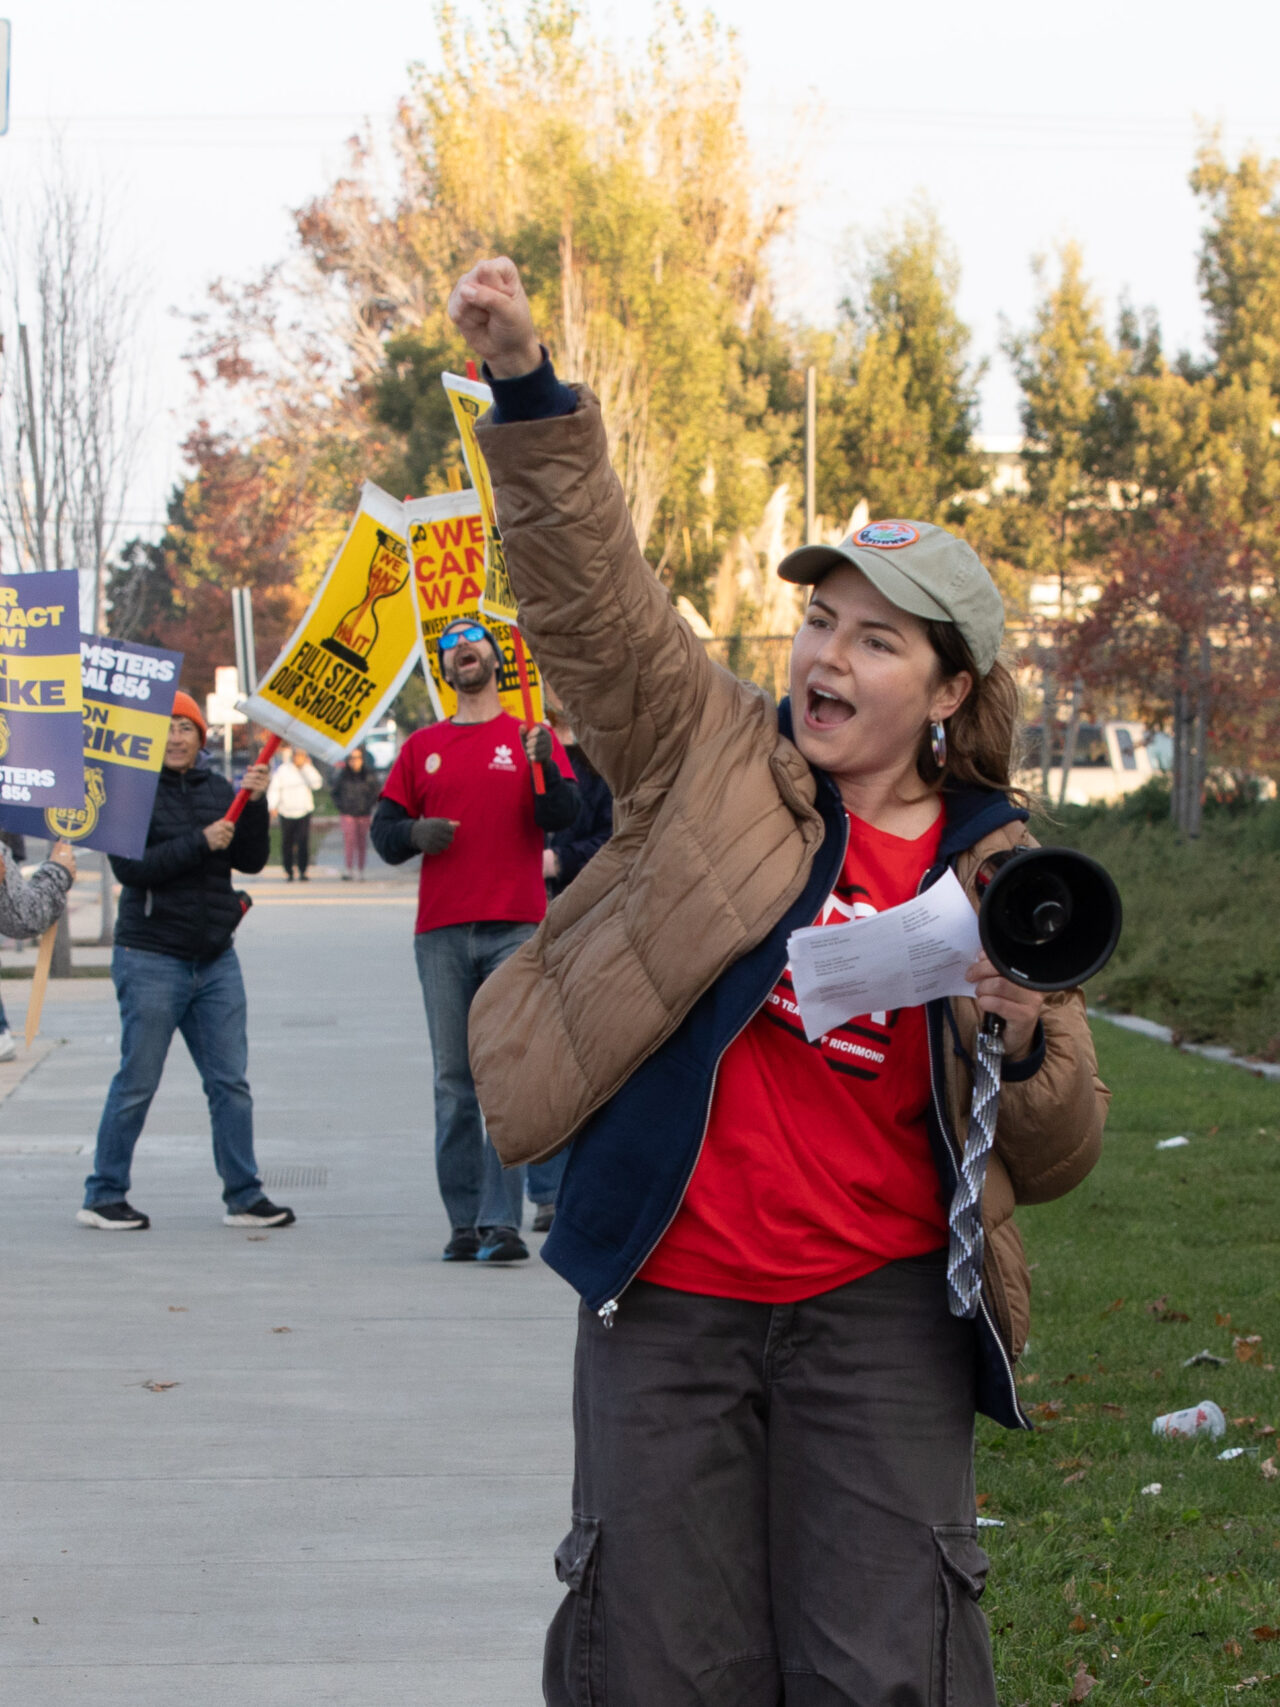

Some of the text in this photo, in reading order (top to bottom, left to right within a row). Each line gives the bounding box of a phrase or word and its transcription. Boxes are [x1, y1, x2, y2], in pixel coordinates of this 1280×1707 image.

[432, 515, 485, 550] WE
[380, 552, 402, 573] WE
[110, 673, 151, 700] 856
[325, 663, 377, 707] STAFF
[268, 666, 361, 733] OUR SCHOOLS
[1, 783, 32, 802] 856
[829, 1038, 885, 1063] RICHMOND
